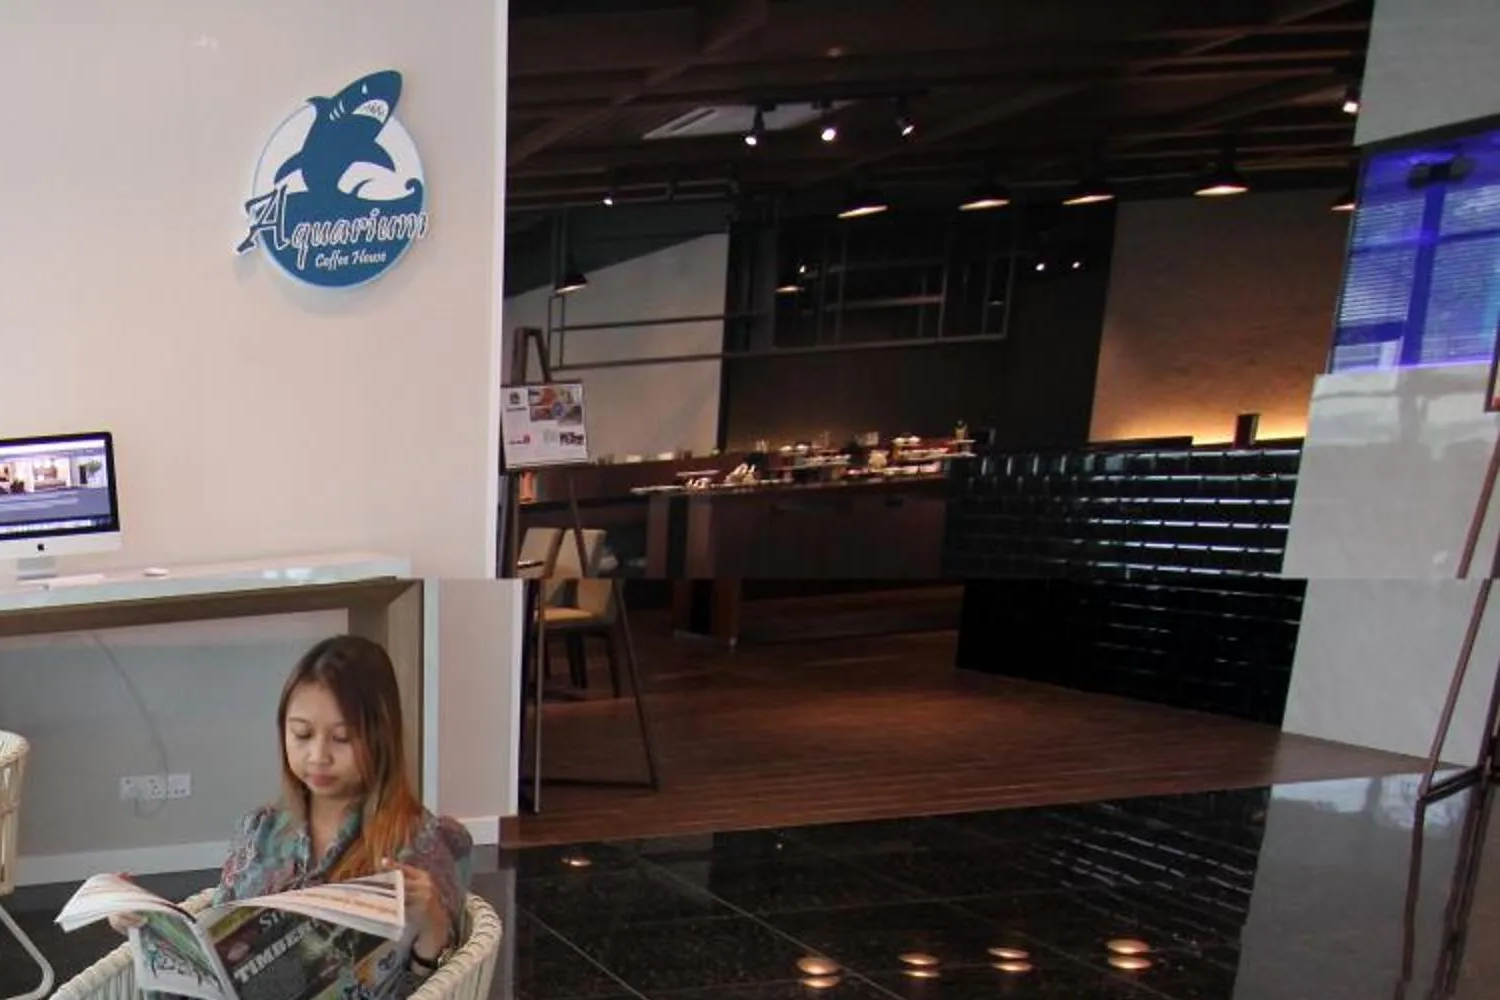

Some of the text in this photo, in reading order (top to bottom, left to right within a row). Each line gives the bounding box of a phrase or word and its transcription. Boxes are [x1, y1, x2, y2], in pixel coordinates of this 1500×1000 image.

[236, 184, 429, 270] Aquarium
[315, 248, 387, 270] Coffee House
